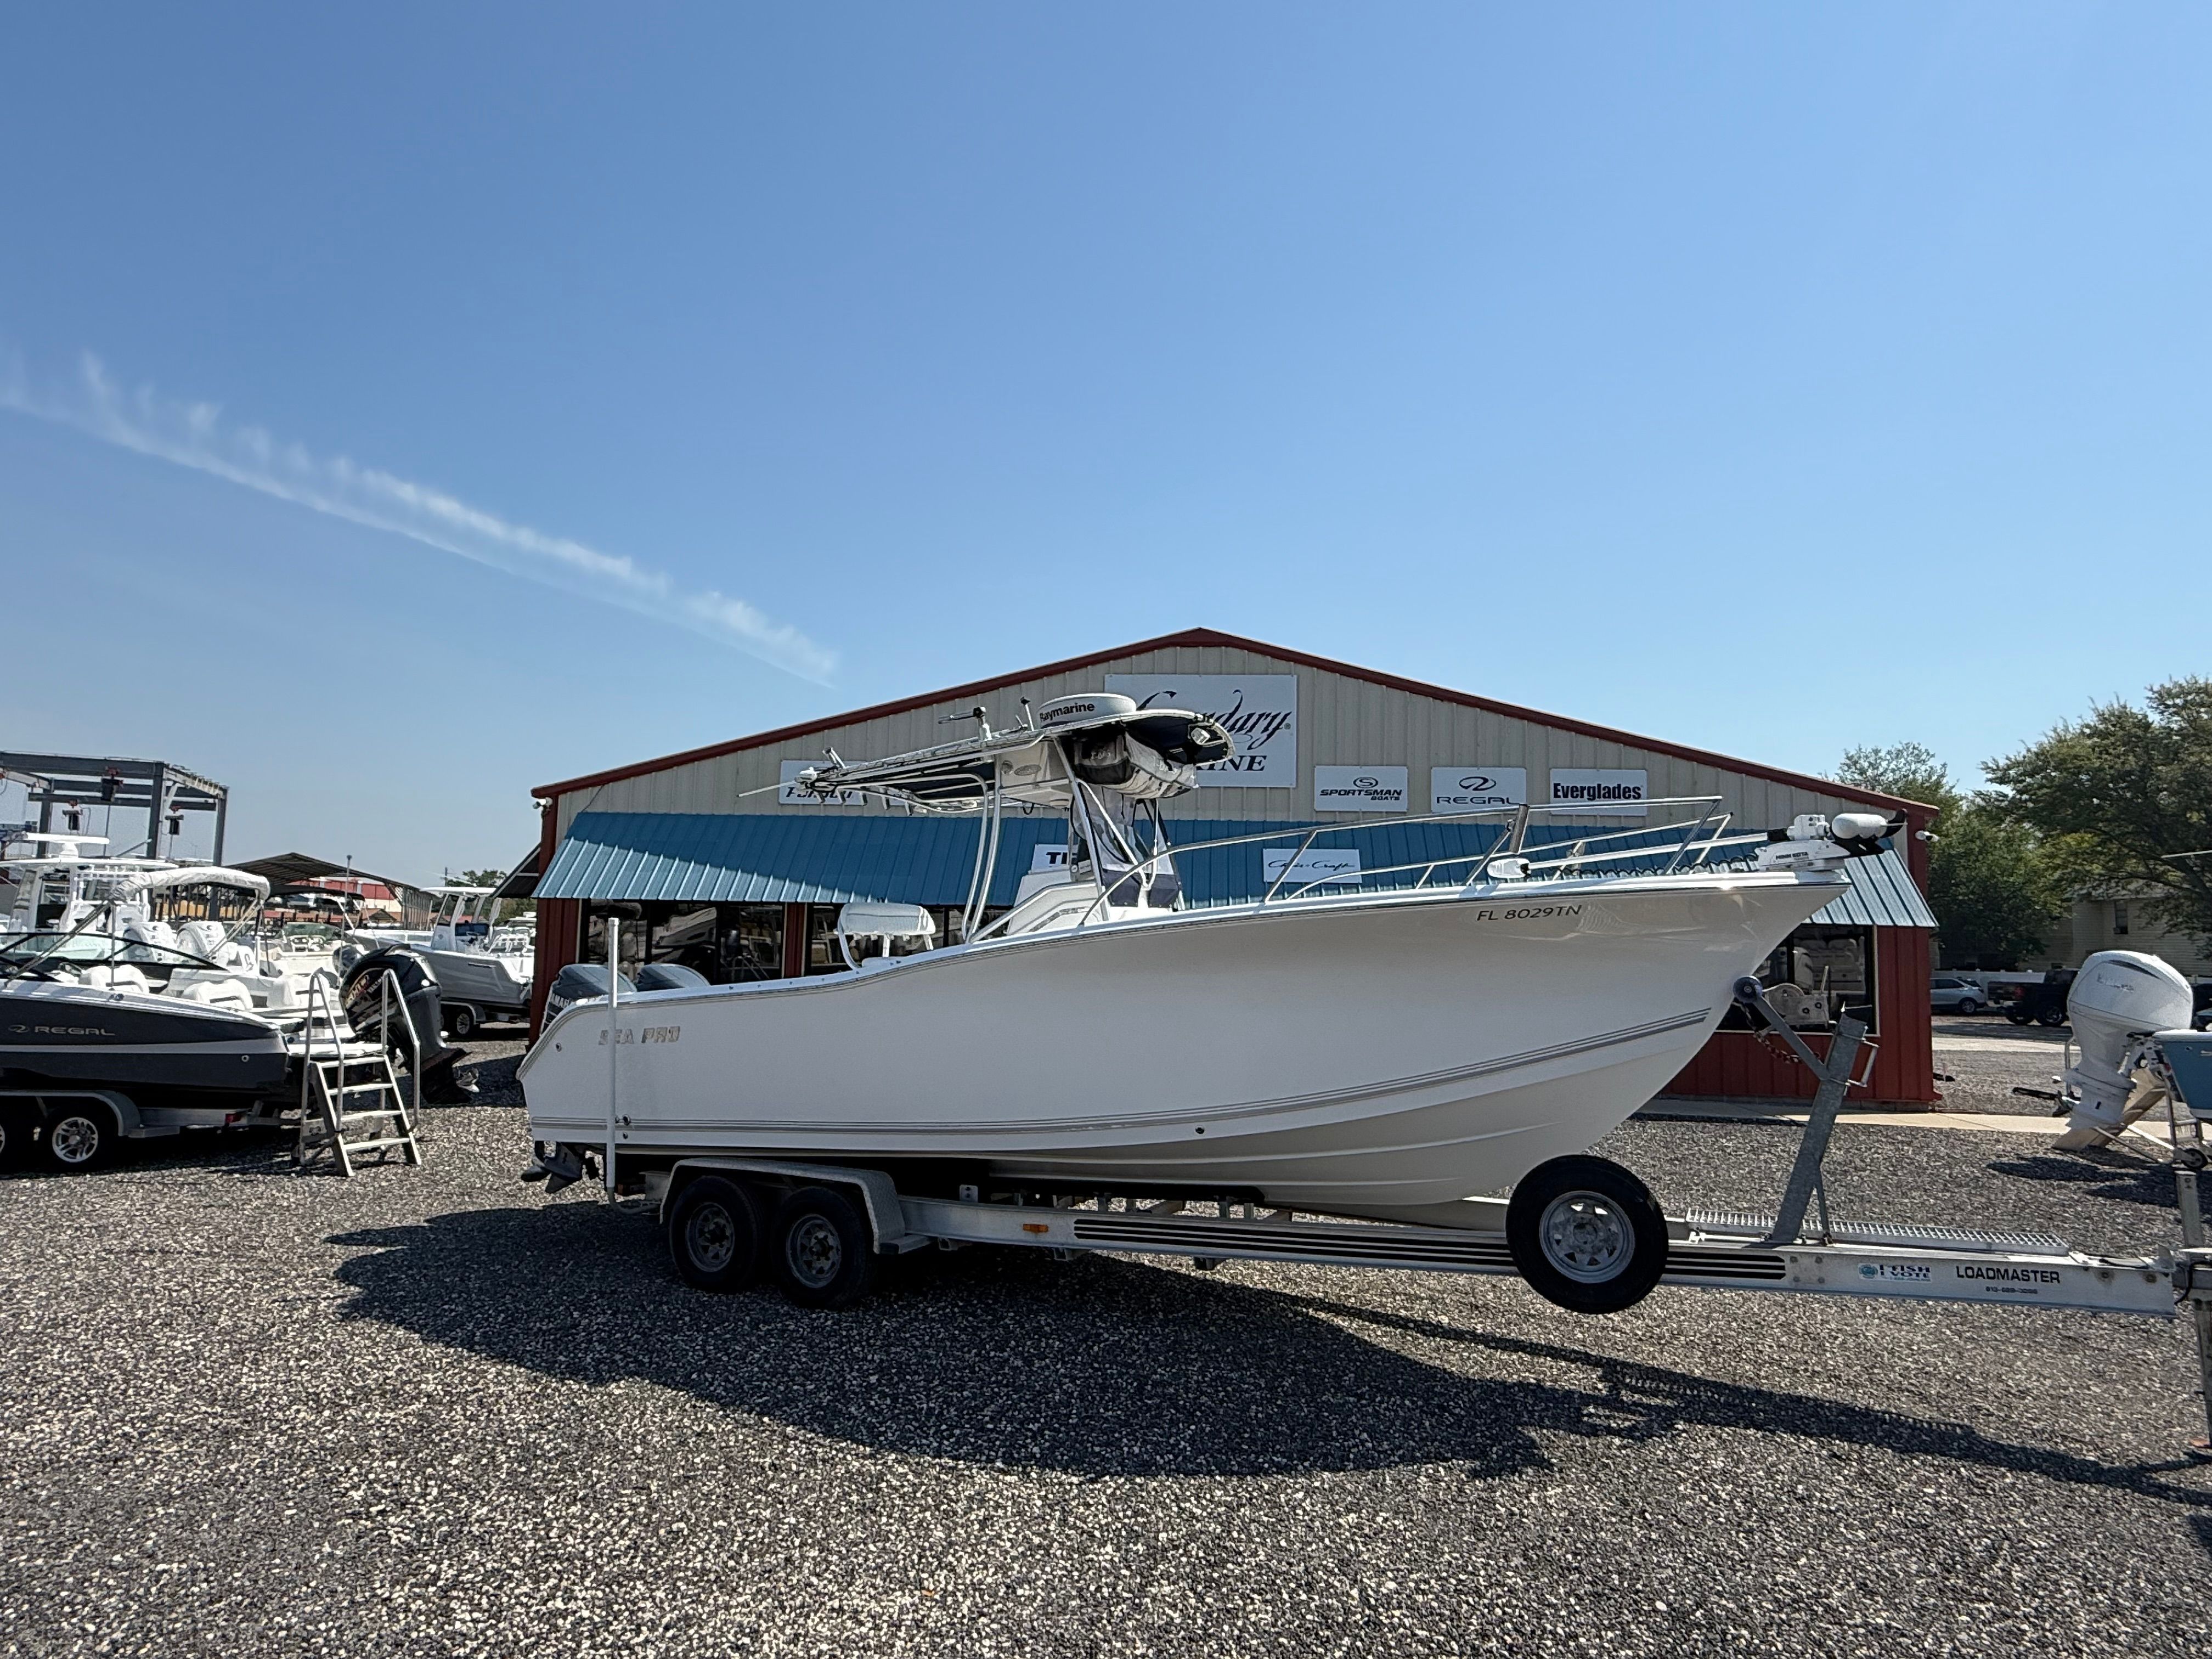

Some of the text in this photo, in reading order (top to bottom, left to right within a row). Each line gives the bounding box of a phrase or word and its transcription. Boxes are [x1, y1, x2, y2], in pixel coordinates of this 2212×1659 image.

[1039, 702, 1095, 723] Raymarine
[1553, 783, 1641, 801] Everglades
[1436, 797, 1521, 805] REGAL
[1477, 905, 1583, 922] FL 8029TN
[34, 1025, 116, 1036] REGAL
[1956, 1265, 2061, 1284] LOADMASTER
